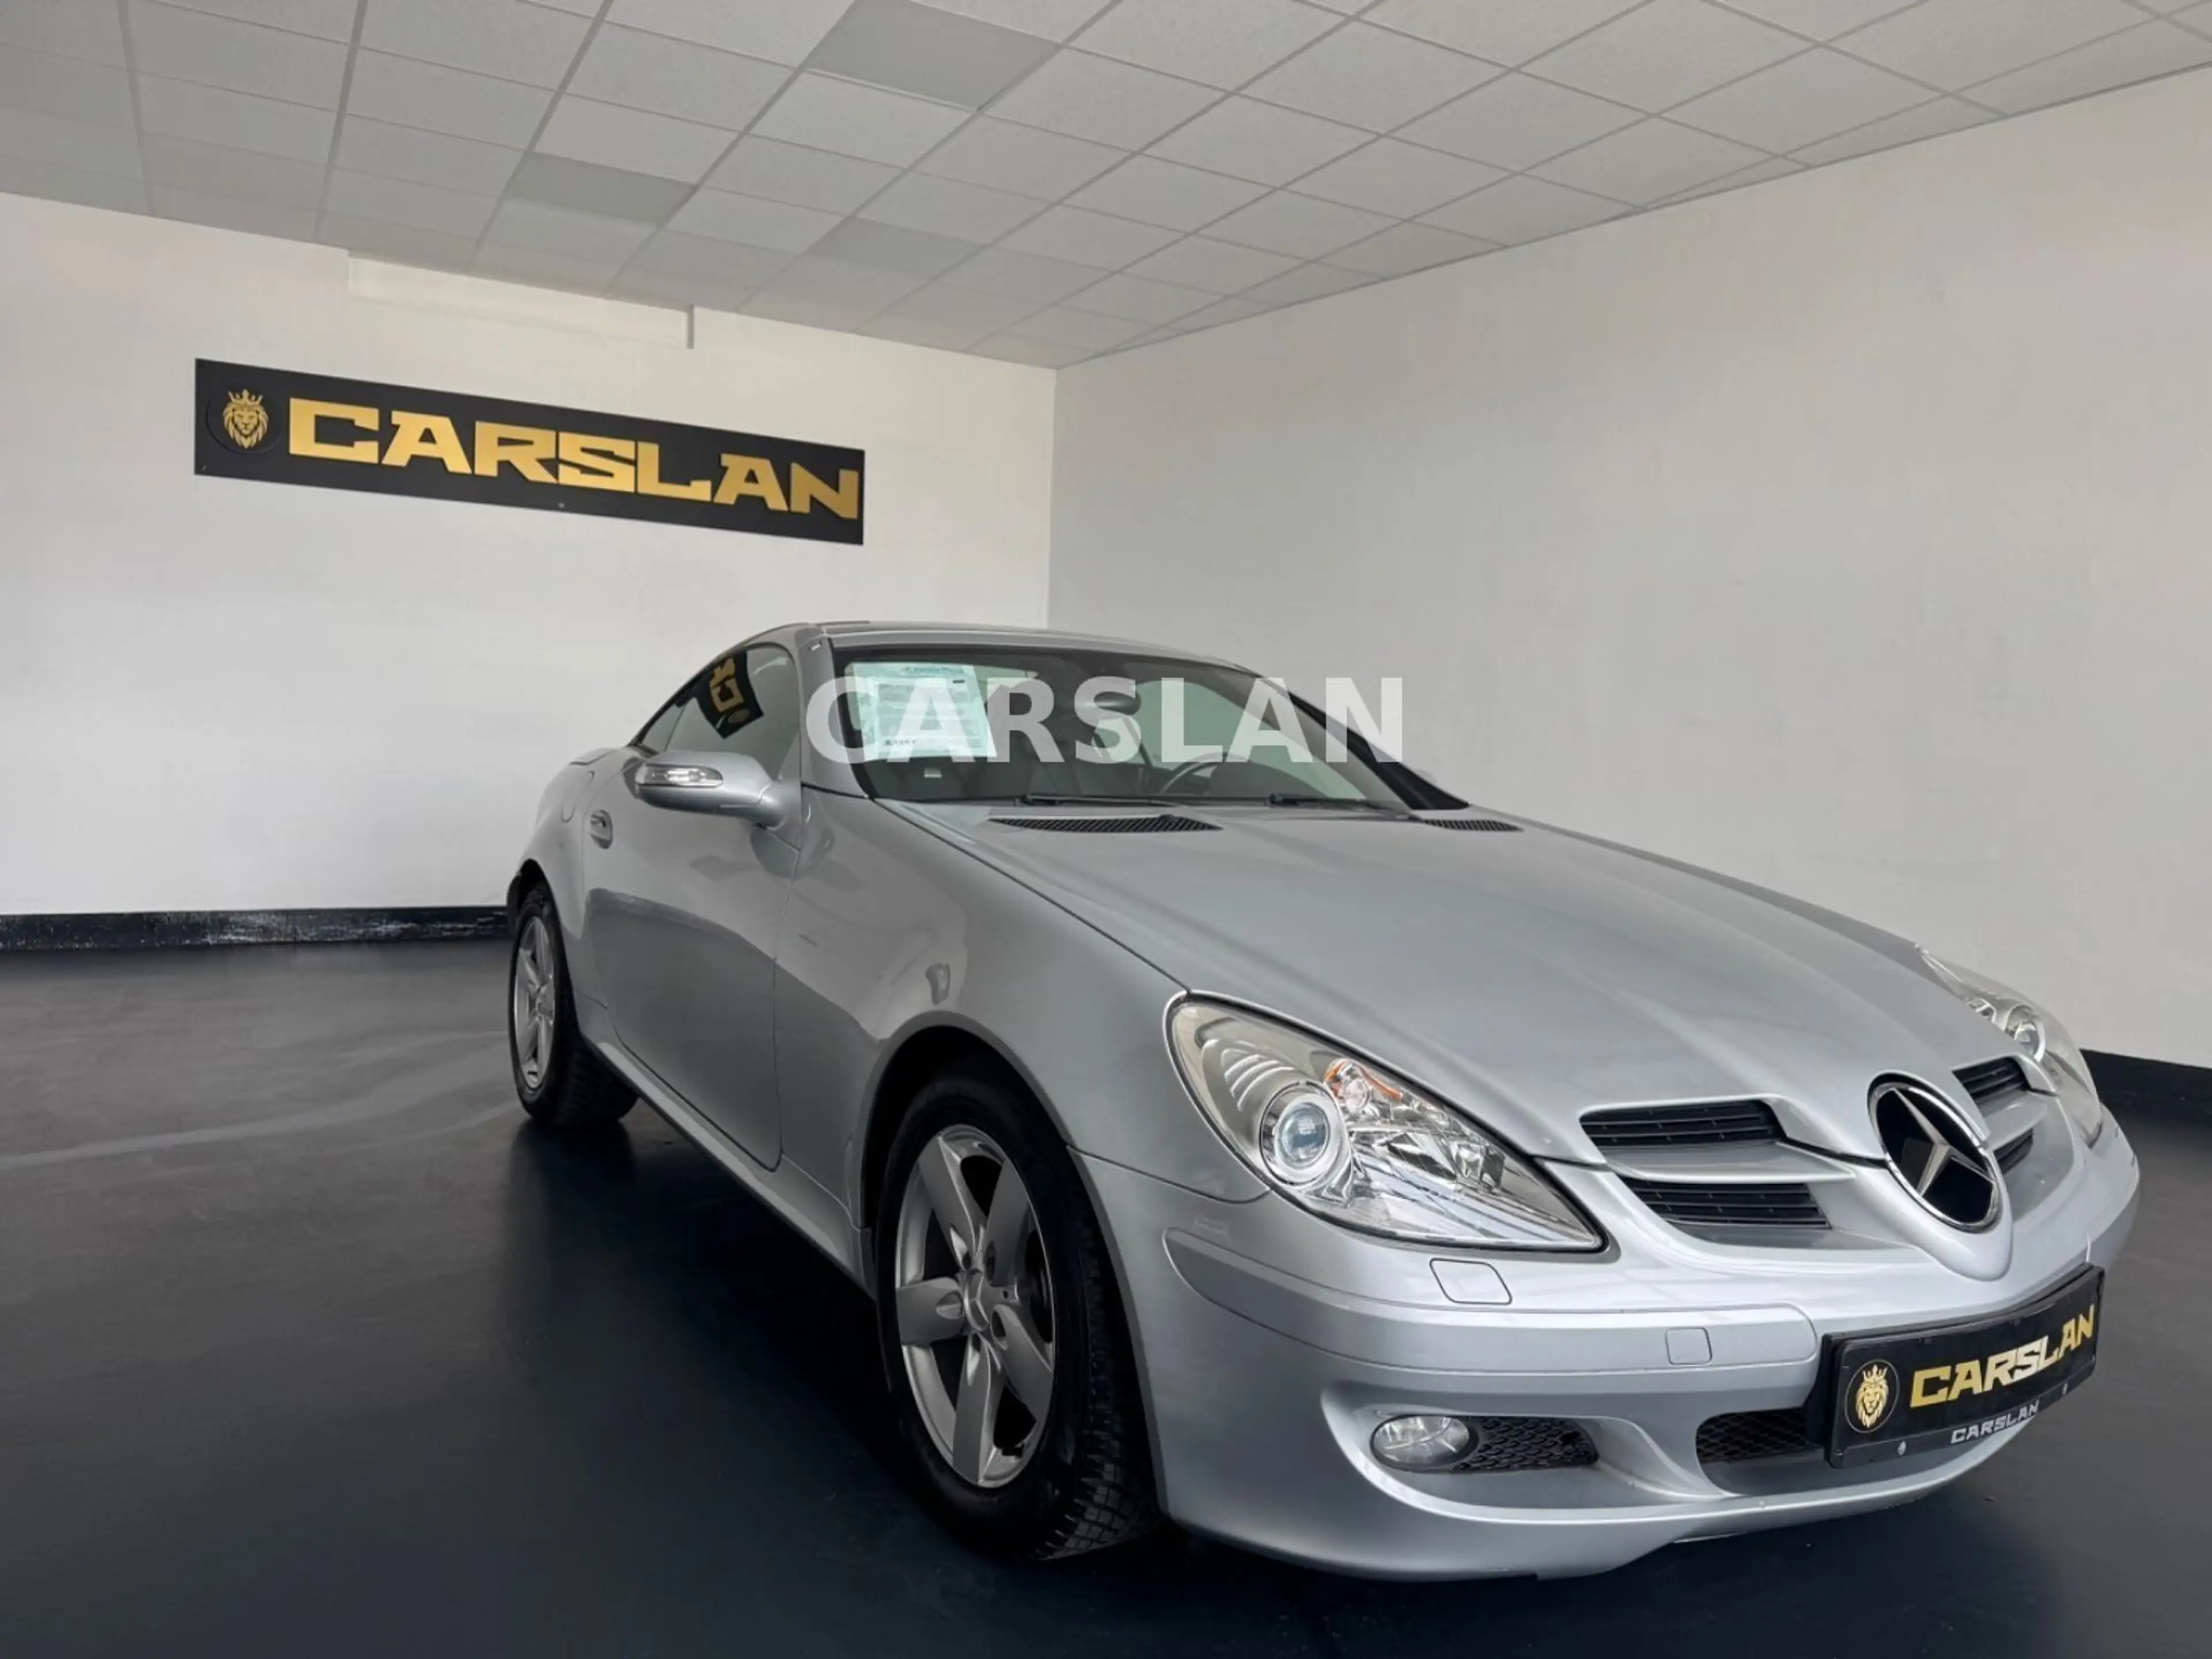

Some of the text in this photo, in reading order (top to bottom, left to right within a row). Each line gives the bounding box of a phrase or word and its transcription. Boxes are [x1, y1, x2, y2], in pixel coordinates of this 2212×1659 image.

[289, 397, 859, 519] CARSLAN
[1909, 1304, 2094, 1408] CARSLAN
[1950, 1400, 2040, 1445] CARSLAN
